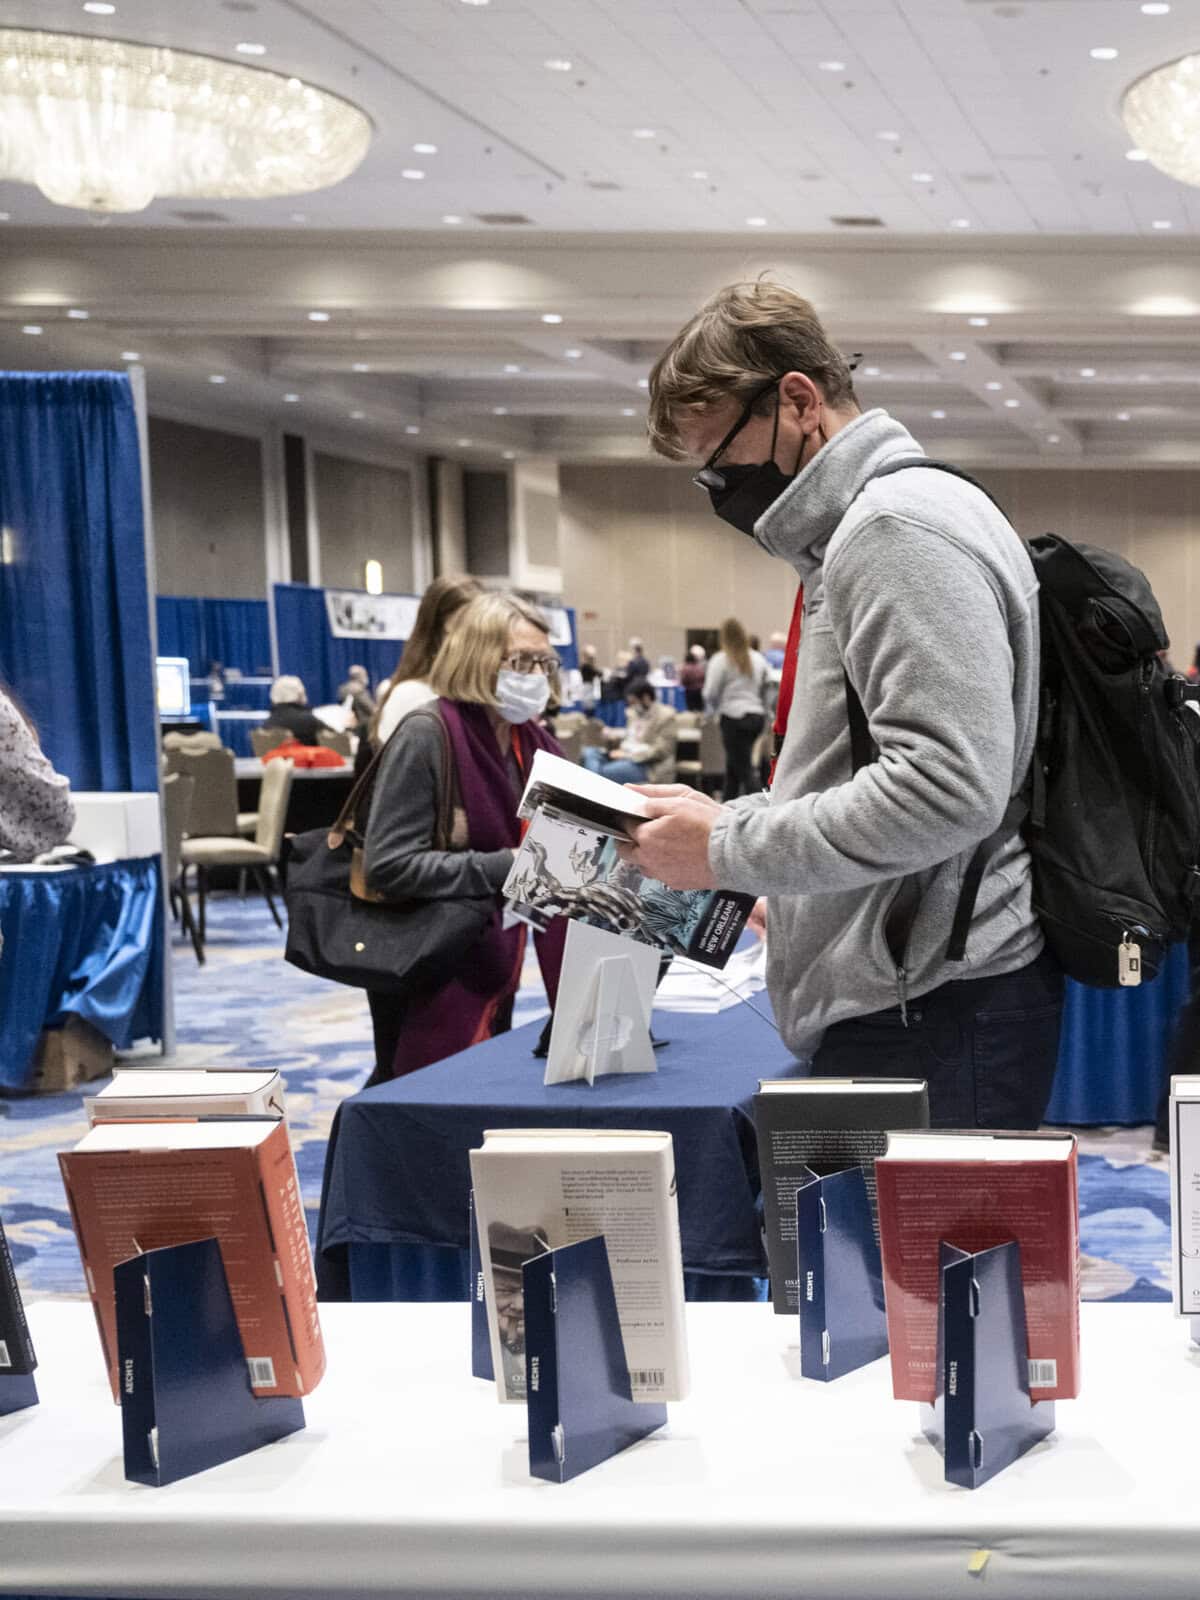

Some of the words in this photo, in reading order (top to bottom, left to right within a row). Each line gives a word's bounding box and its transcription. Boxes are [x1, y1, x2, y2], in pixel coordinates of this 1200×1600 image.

[706, 935, 718, 953] NEW
[714, 901, 736, 935] ORLEANS
[126, 1359, 134, 1395] AECH12
[531, 1356, 539, 1391] AECH12
[949, 1361, 957, 1395] AECH12
